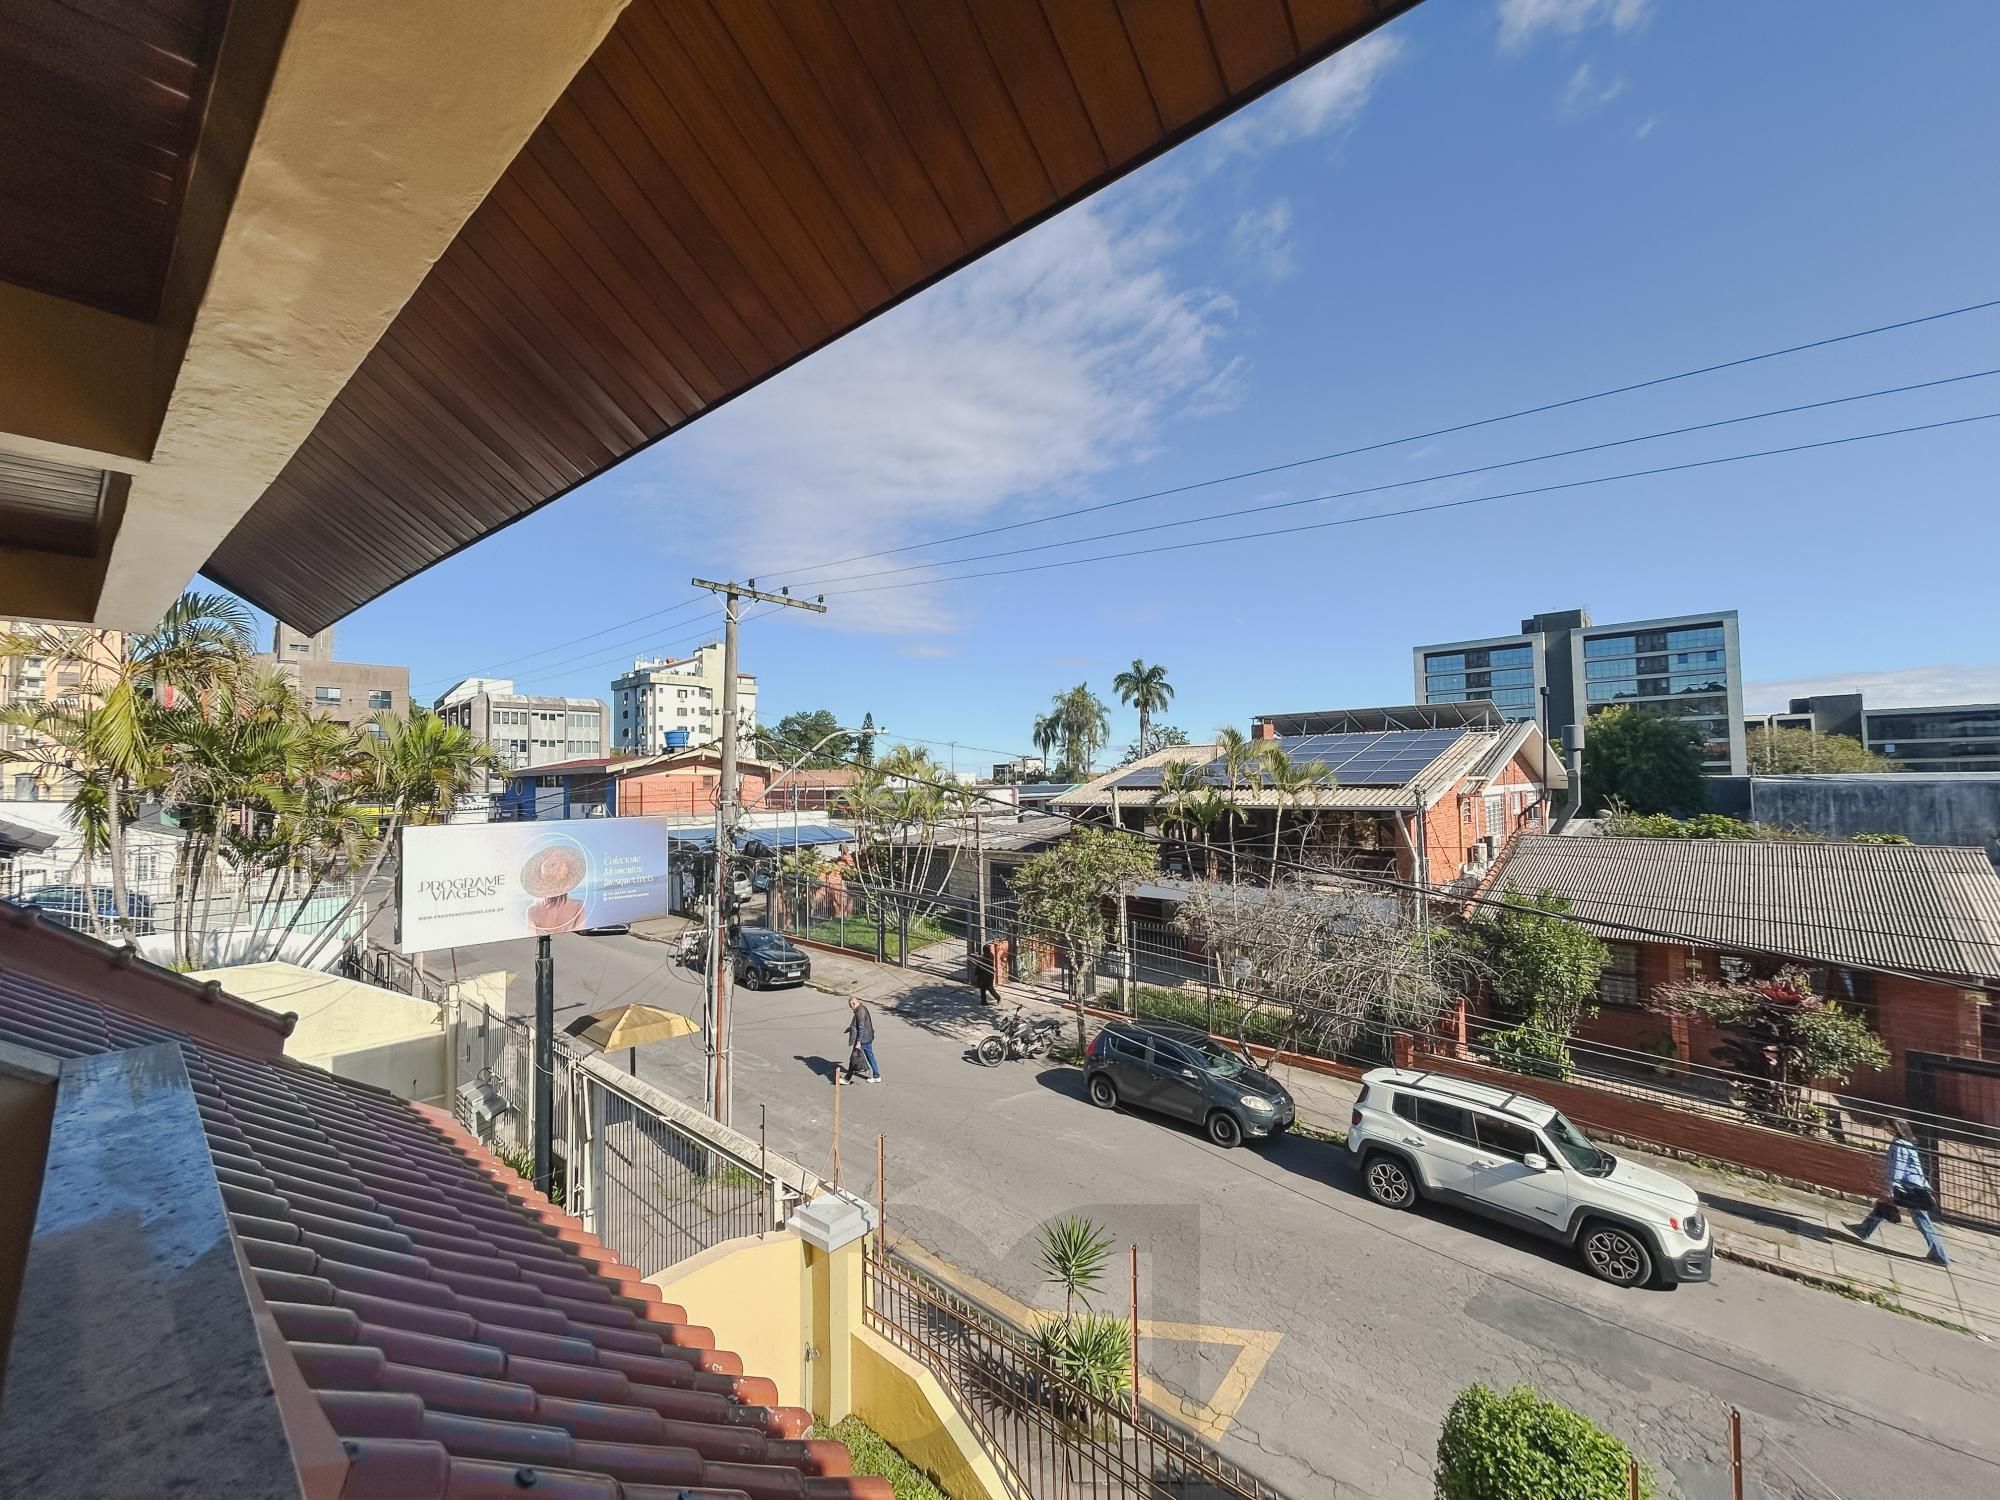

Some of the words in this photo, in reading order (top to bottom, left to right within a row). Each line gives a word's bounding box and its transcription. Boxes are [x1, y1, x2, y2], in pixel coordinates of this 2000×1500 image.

[604, 855, 641, 866] Colecione
[417, 874, 505, 893] PROGRAME
[431, 885, 496, 901] VIAGENS
